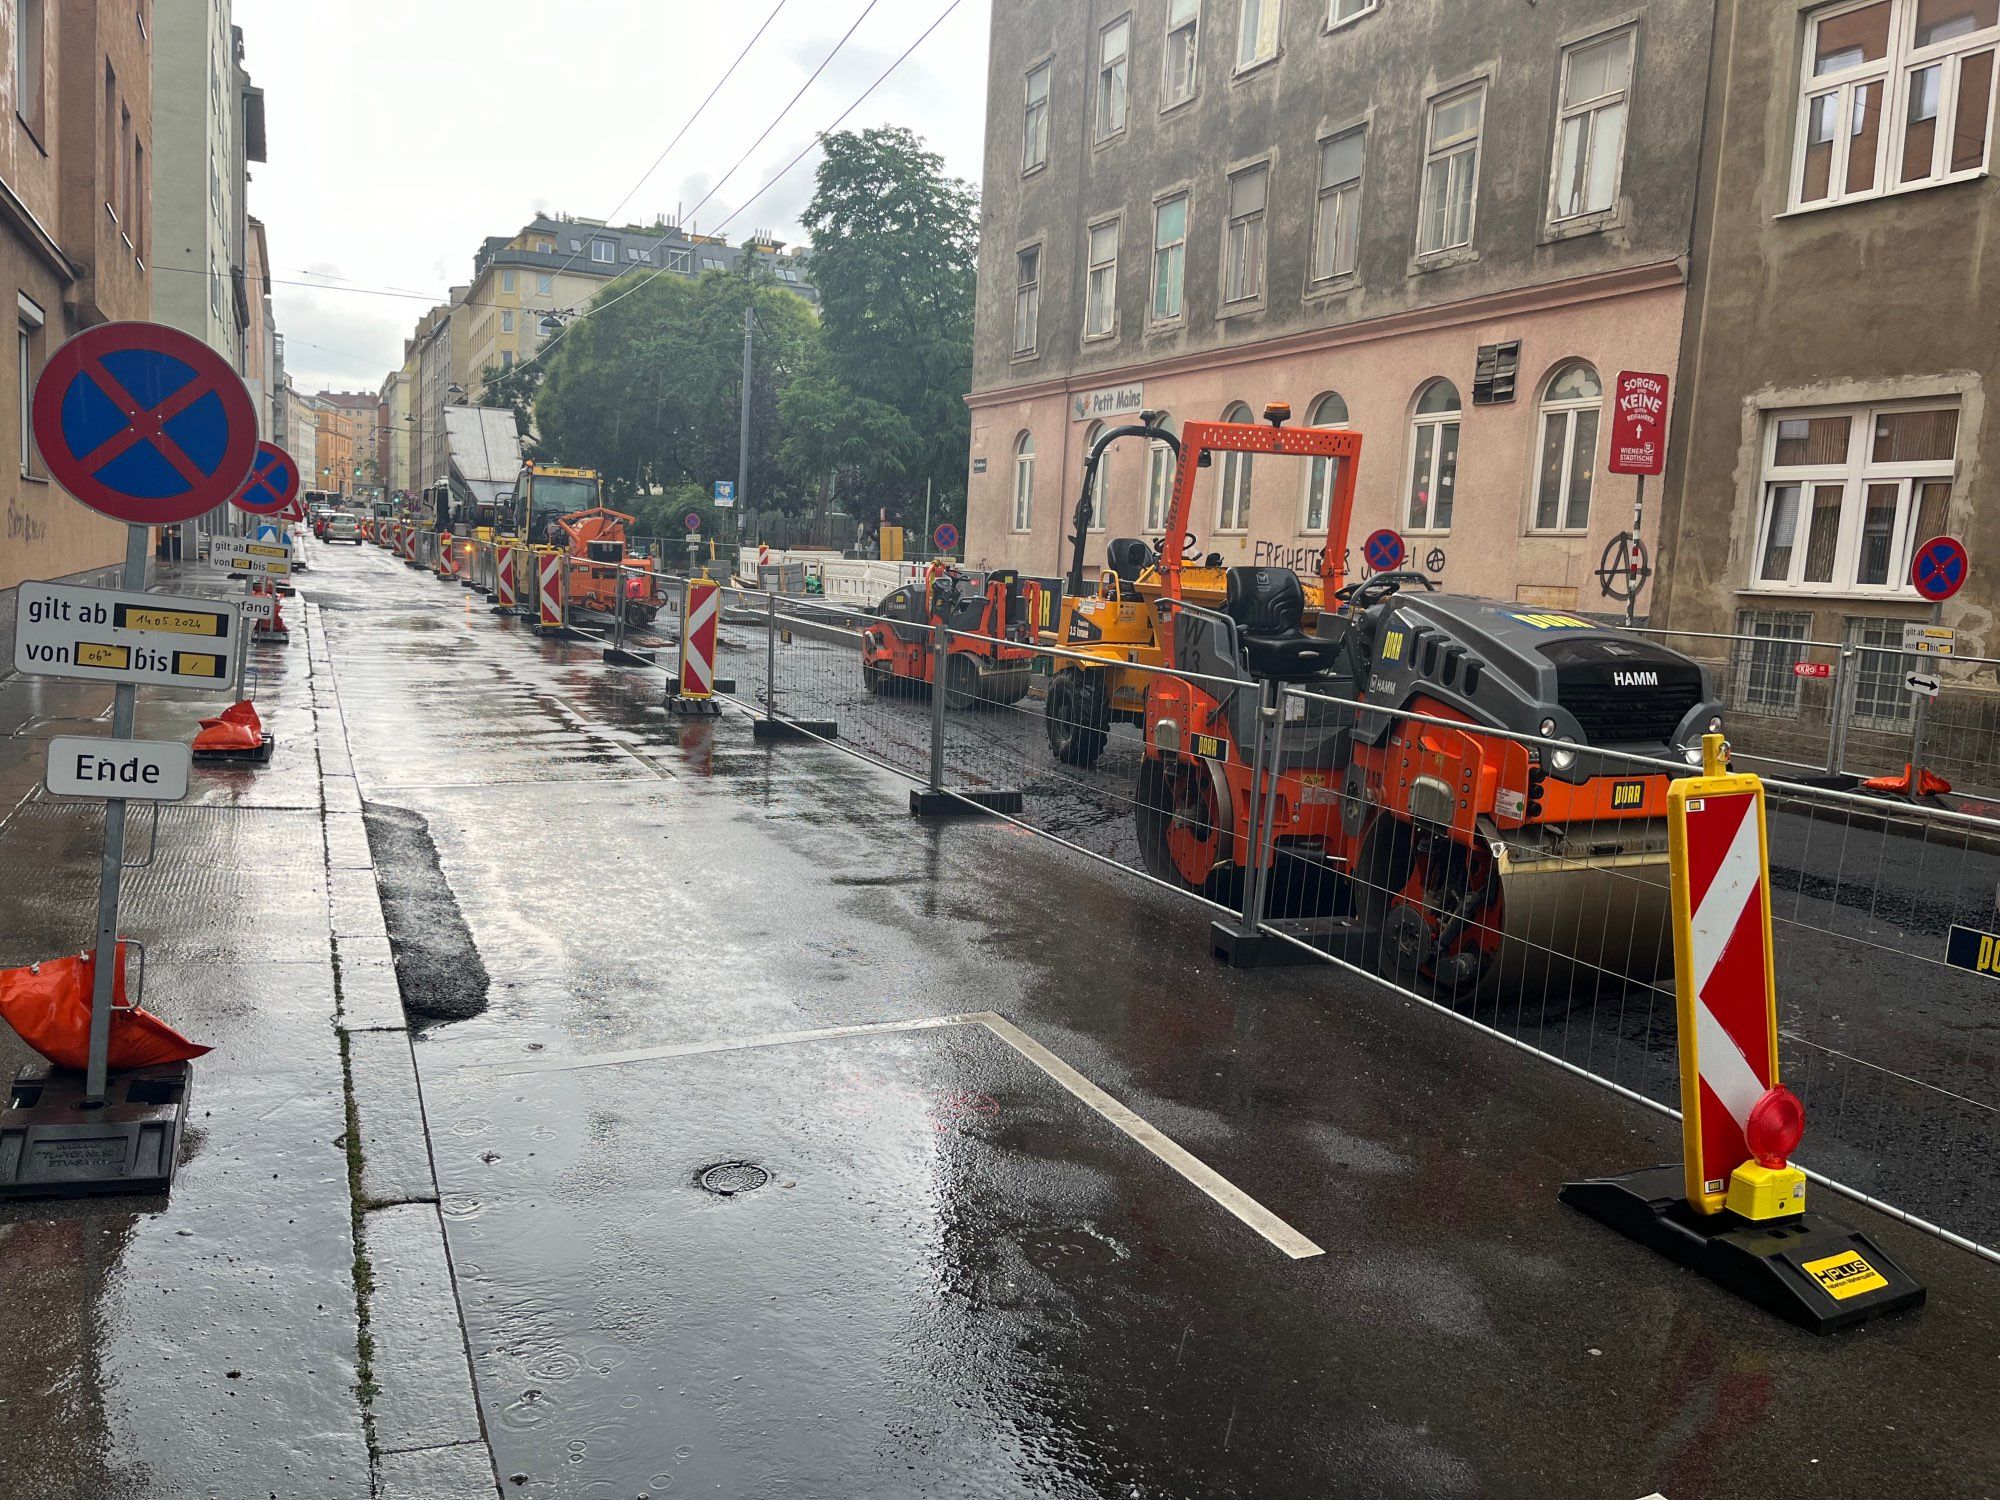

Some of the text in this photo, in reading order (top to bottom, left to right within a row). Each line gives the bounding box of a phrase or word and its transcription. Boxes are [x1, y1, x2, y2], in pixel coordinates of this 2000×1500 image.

[1624, 378, 1661, 394] SORGEN
[1093, 389, 1141, 412] Petit Mains
[1620, 394, 1662, 413] KEINE
[1620, 447, 1644, 455] WIENER
[1168, 443, 1189, 532] OSCILLATION
[215, 542, 231, 551] gilt
[233, 545, 244, 553] ab
[213, 558, 230, 566] von
[253, 562, 266, 570] bis
[1254, 540, 1320, 573] FREIHEIT
[29, 597, 71, 623] gilt
[78, 603, 107, 625] ab
[235, 601, 270, 615] fang
[1905, 628, 1916, 637] gilt
[1917, 629, 1925, 637] ab
[1929, 643, 1939, 651] bis
[25, 643, 69, 663] von
[135, 648, 168, 672] bis
[1376, 679, 1396, 695] HAMM
[1613, 672, 1658, 686] HAMM
[76, 754, 160, 783] Ende
[1615, 785, 1641, 805] PORR
[1814, 1260, 1870, 1284] HPLUS
